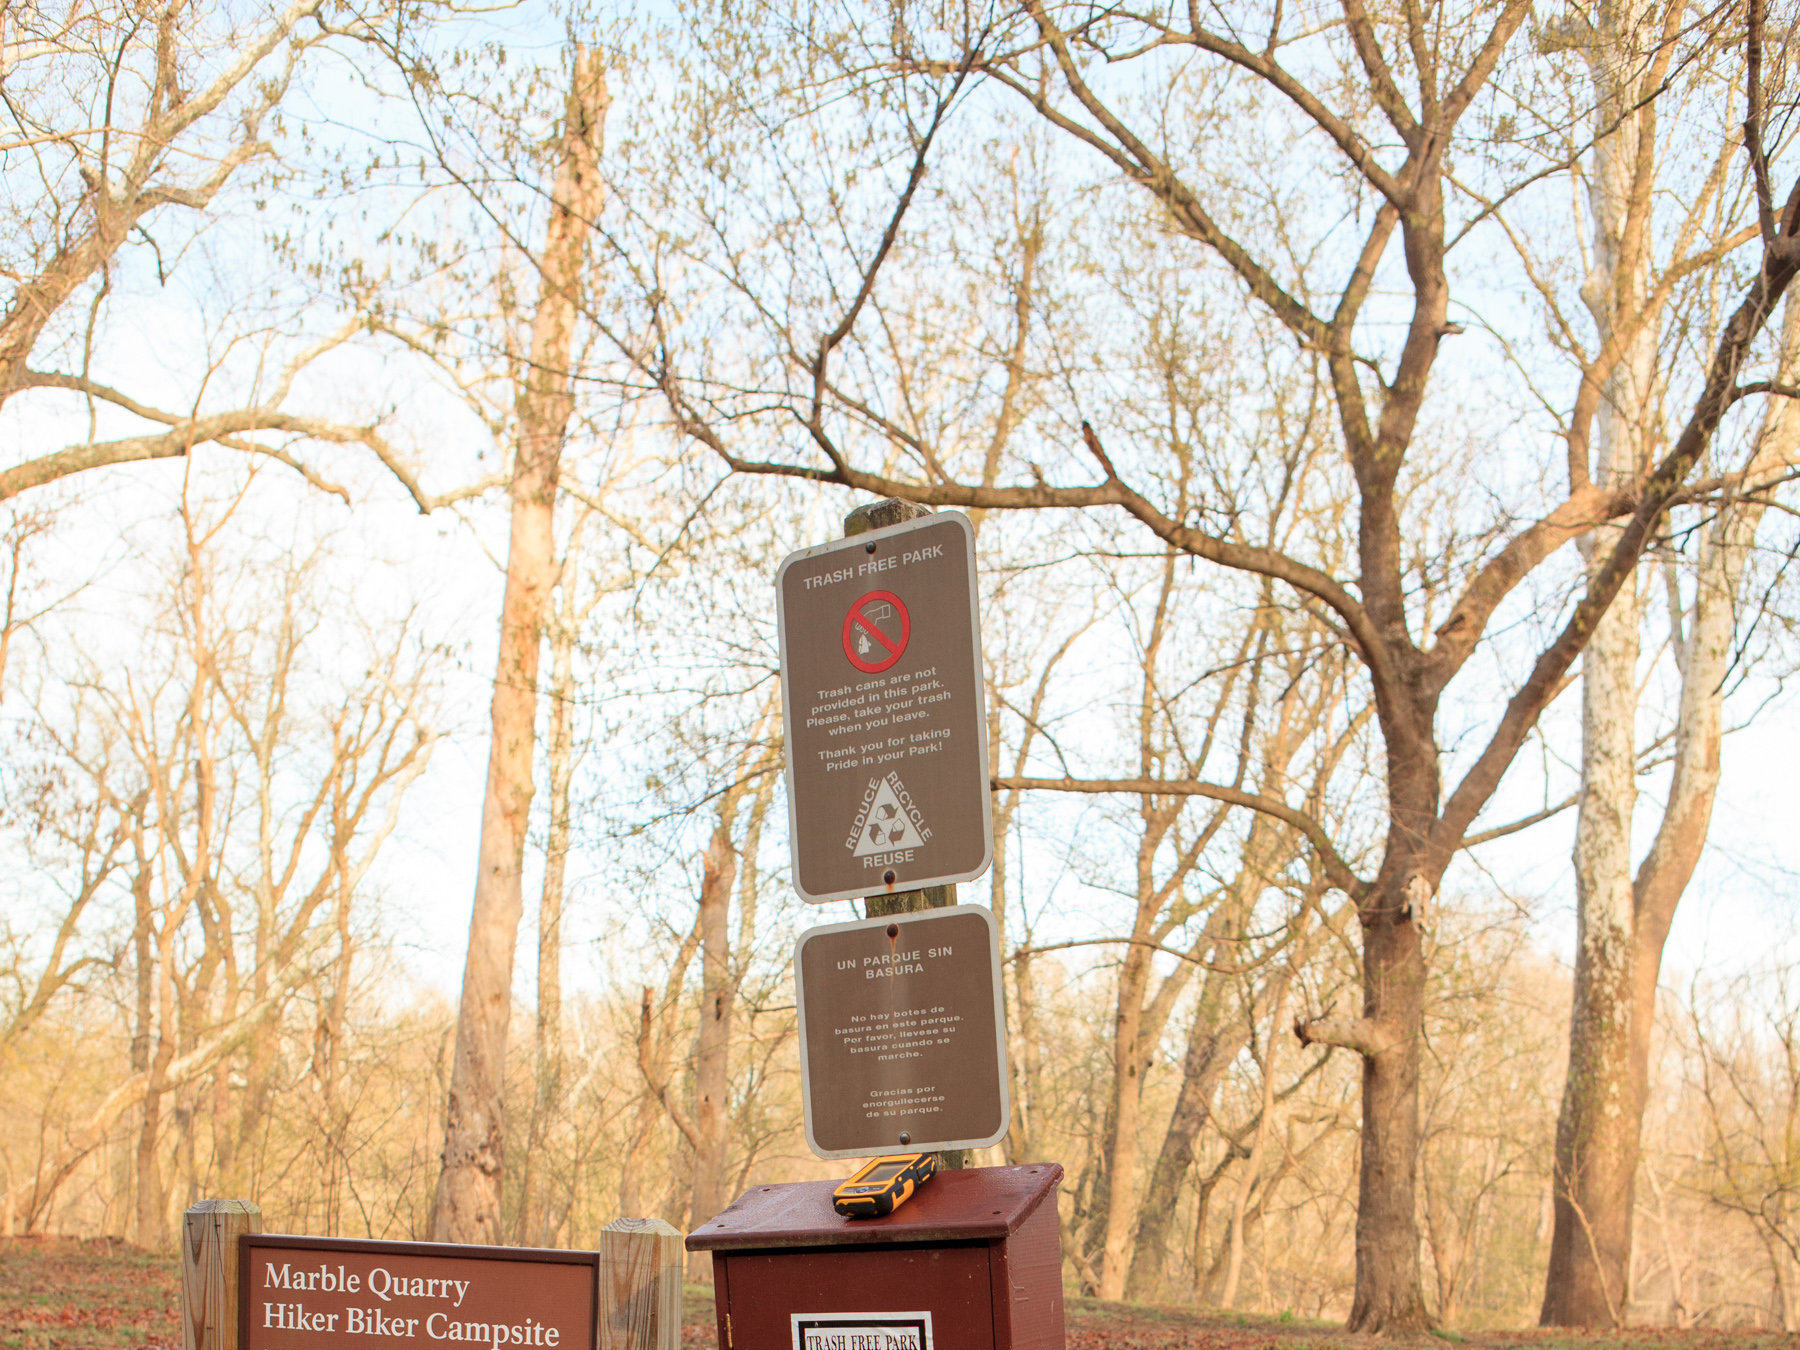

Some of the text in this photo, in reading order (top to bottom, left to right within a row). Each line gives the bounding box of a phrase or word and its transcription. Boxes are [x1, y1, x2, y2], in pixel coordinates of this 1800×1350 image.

[803, 544, 944, 590] TRASH FREE PARK
[817, 666, 937, 700] Trash cans are not
[806, 690, 952, 728] Please, take your trash
[811, 680, 945, 716] provided in this park.
[829, 710, 930, 736] when you leave.
[818, 728, 951, 760] Thank you for taking
[826, 741, 943, 772] Pride in your Park!
[845, 777, 880, 850] REDUCE
[887, 770, 933, 842] RECYCLE
[863, 850, 914, 869] REUSE
[837, 946, 953, 970] UN PARQUE SIN
[866, 963, 924, 979] BASURA
[835, 1025, 872, 1035] basura
[892, 1020, 917, 1028] este
[921, 1015, 964, 1026] parque.
[870, 1013, 890, 1021] hay
[894, 1008, 927, 1018] botes
[850, 1044, 888, 1054] basura
[892, 1039, 933, 1049] cuando
[866, 1033, 897, 1042] favor,
[900, 1028, 939, 1038] llevese
[878, 1051, 923, 1061] marche.
[862, 1096, 945, 1108] enorgullecerse
[870, 1086, 936, 1097] Gracias por
[900, 1106, 943, 1116] parque.
[264, 1262, 470, 1307] Marble Quarry
[263, 1302, 560, 1350] Hiker Biker Campsite
